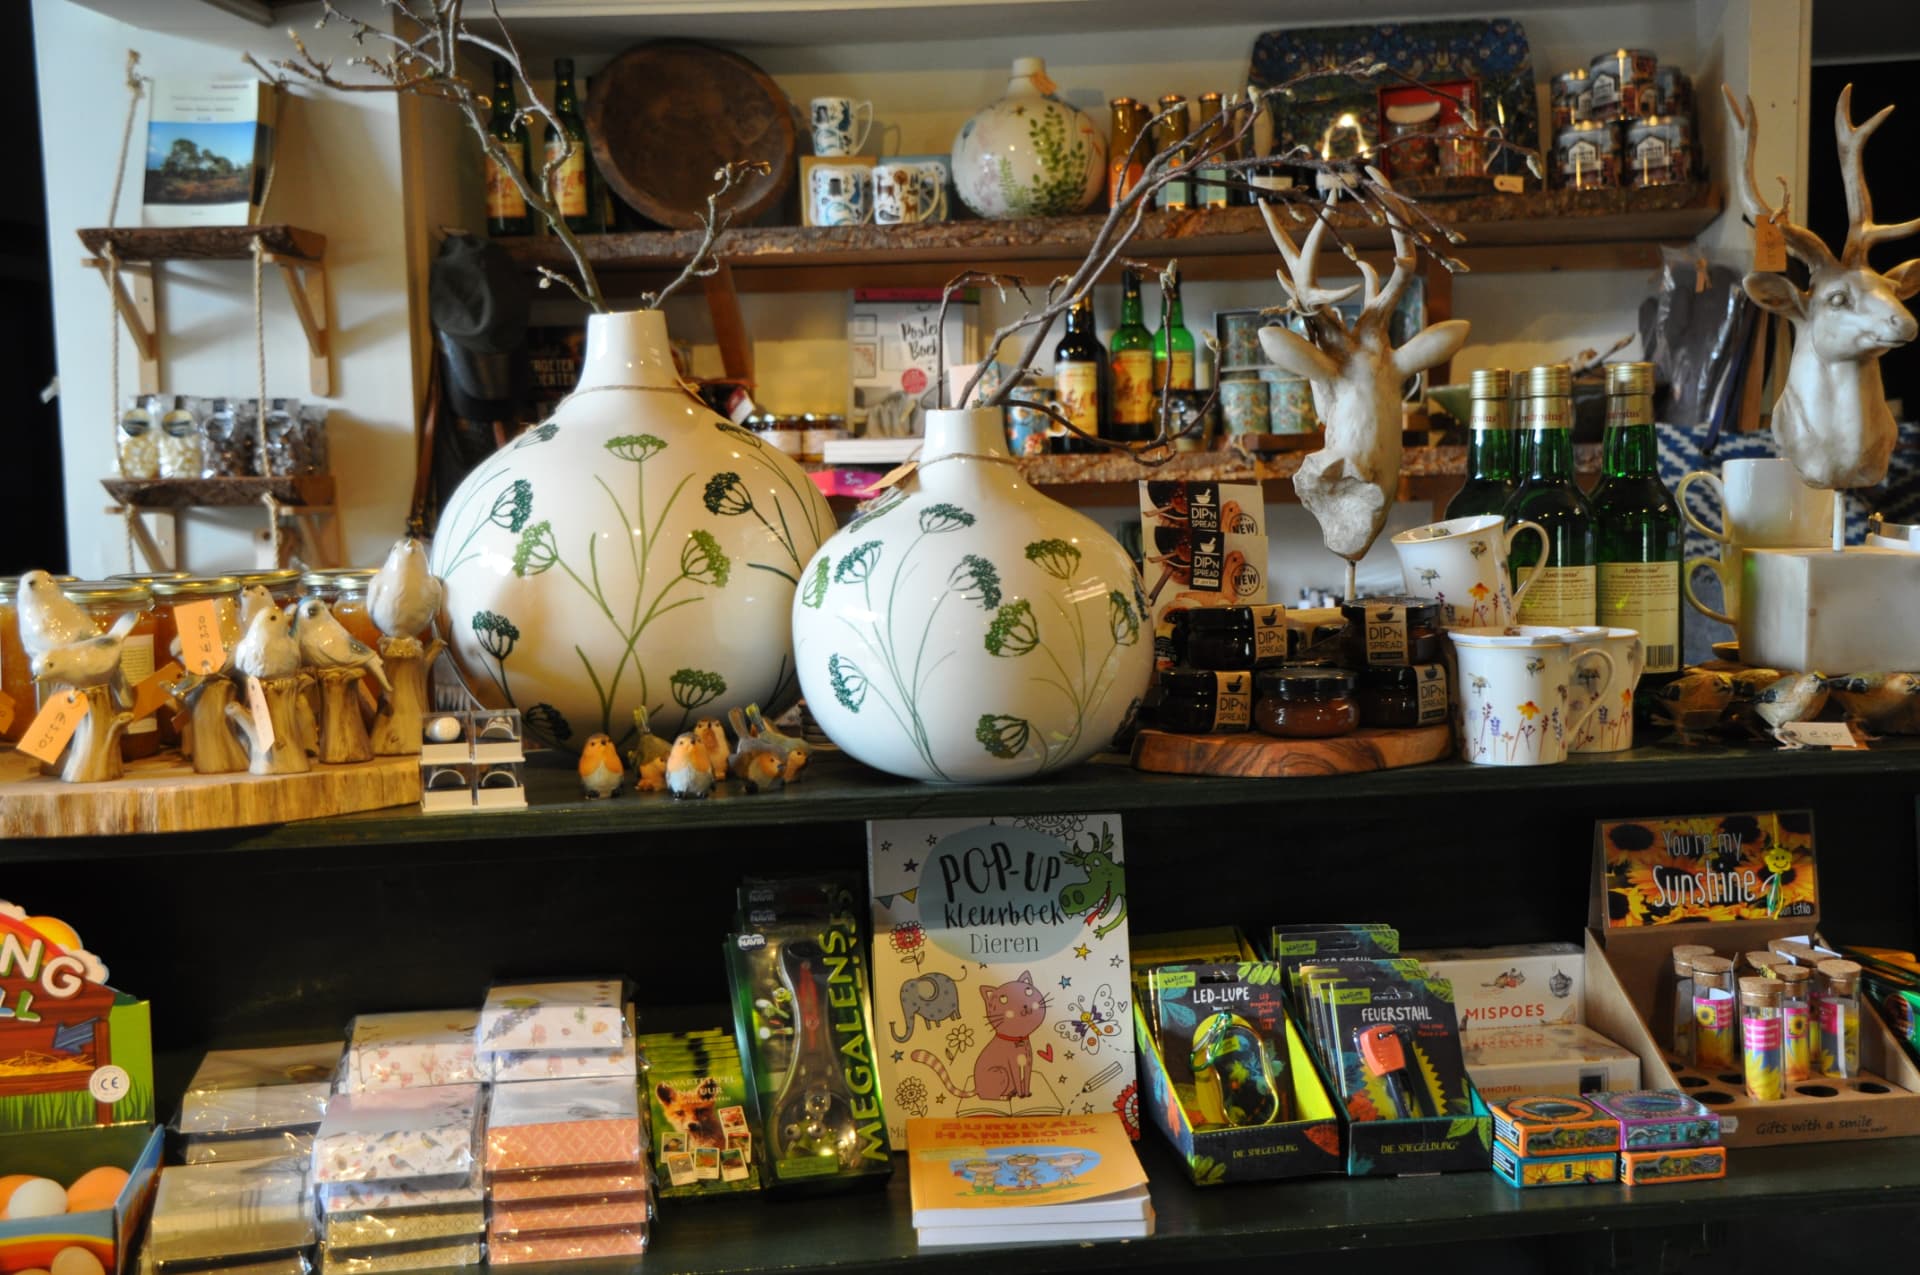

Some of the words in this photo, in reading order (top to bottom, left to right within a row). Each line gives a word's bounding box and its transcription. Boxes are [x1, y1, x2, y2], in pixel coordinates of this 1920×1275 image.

[1191, 520, 1217, 528] SPREAD
[1194, 569, 1220, 578] SPREAD
[1234, 574, 1257, 586] NEW
[1662, 830, 1712, 857] You're
[1717, 831, 1742, 861] my
[939, 842, 1062, 903] POP-UP
[1652, 859, 1756, 908] Sunshine
[944, 899, 1065, 929] kleurboek
[968, 932, 1039, 954] Dieren
[1193, 987, 1250, 1004] LED-LUPE
[1361, 1006, 1432, 1022] FEUERSTAHL
[1466, 1004, 1545, 1021] MISPOES
[818, 930, 889, 1161] MEGALENS
[1756, 1120, 1787, 1136] Gifts
[1791, 1116, 1821, 1131] with
[1826, 1121, 1834, 1130] a
[1838, 1114, 1873, 1128] smile
[1233, 1150, 1244, 1159] DIE
[1381, 1143, 1393, 1154] DIE
